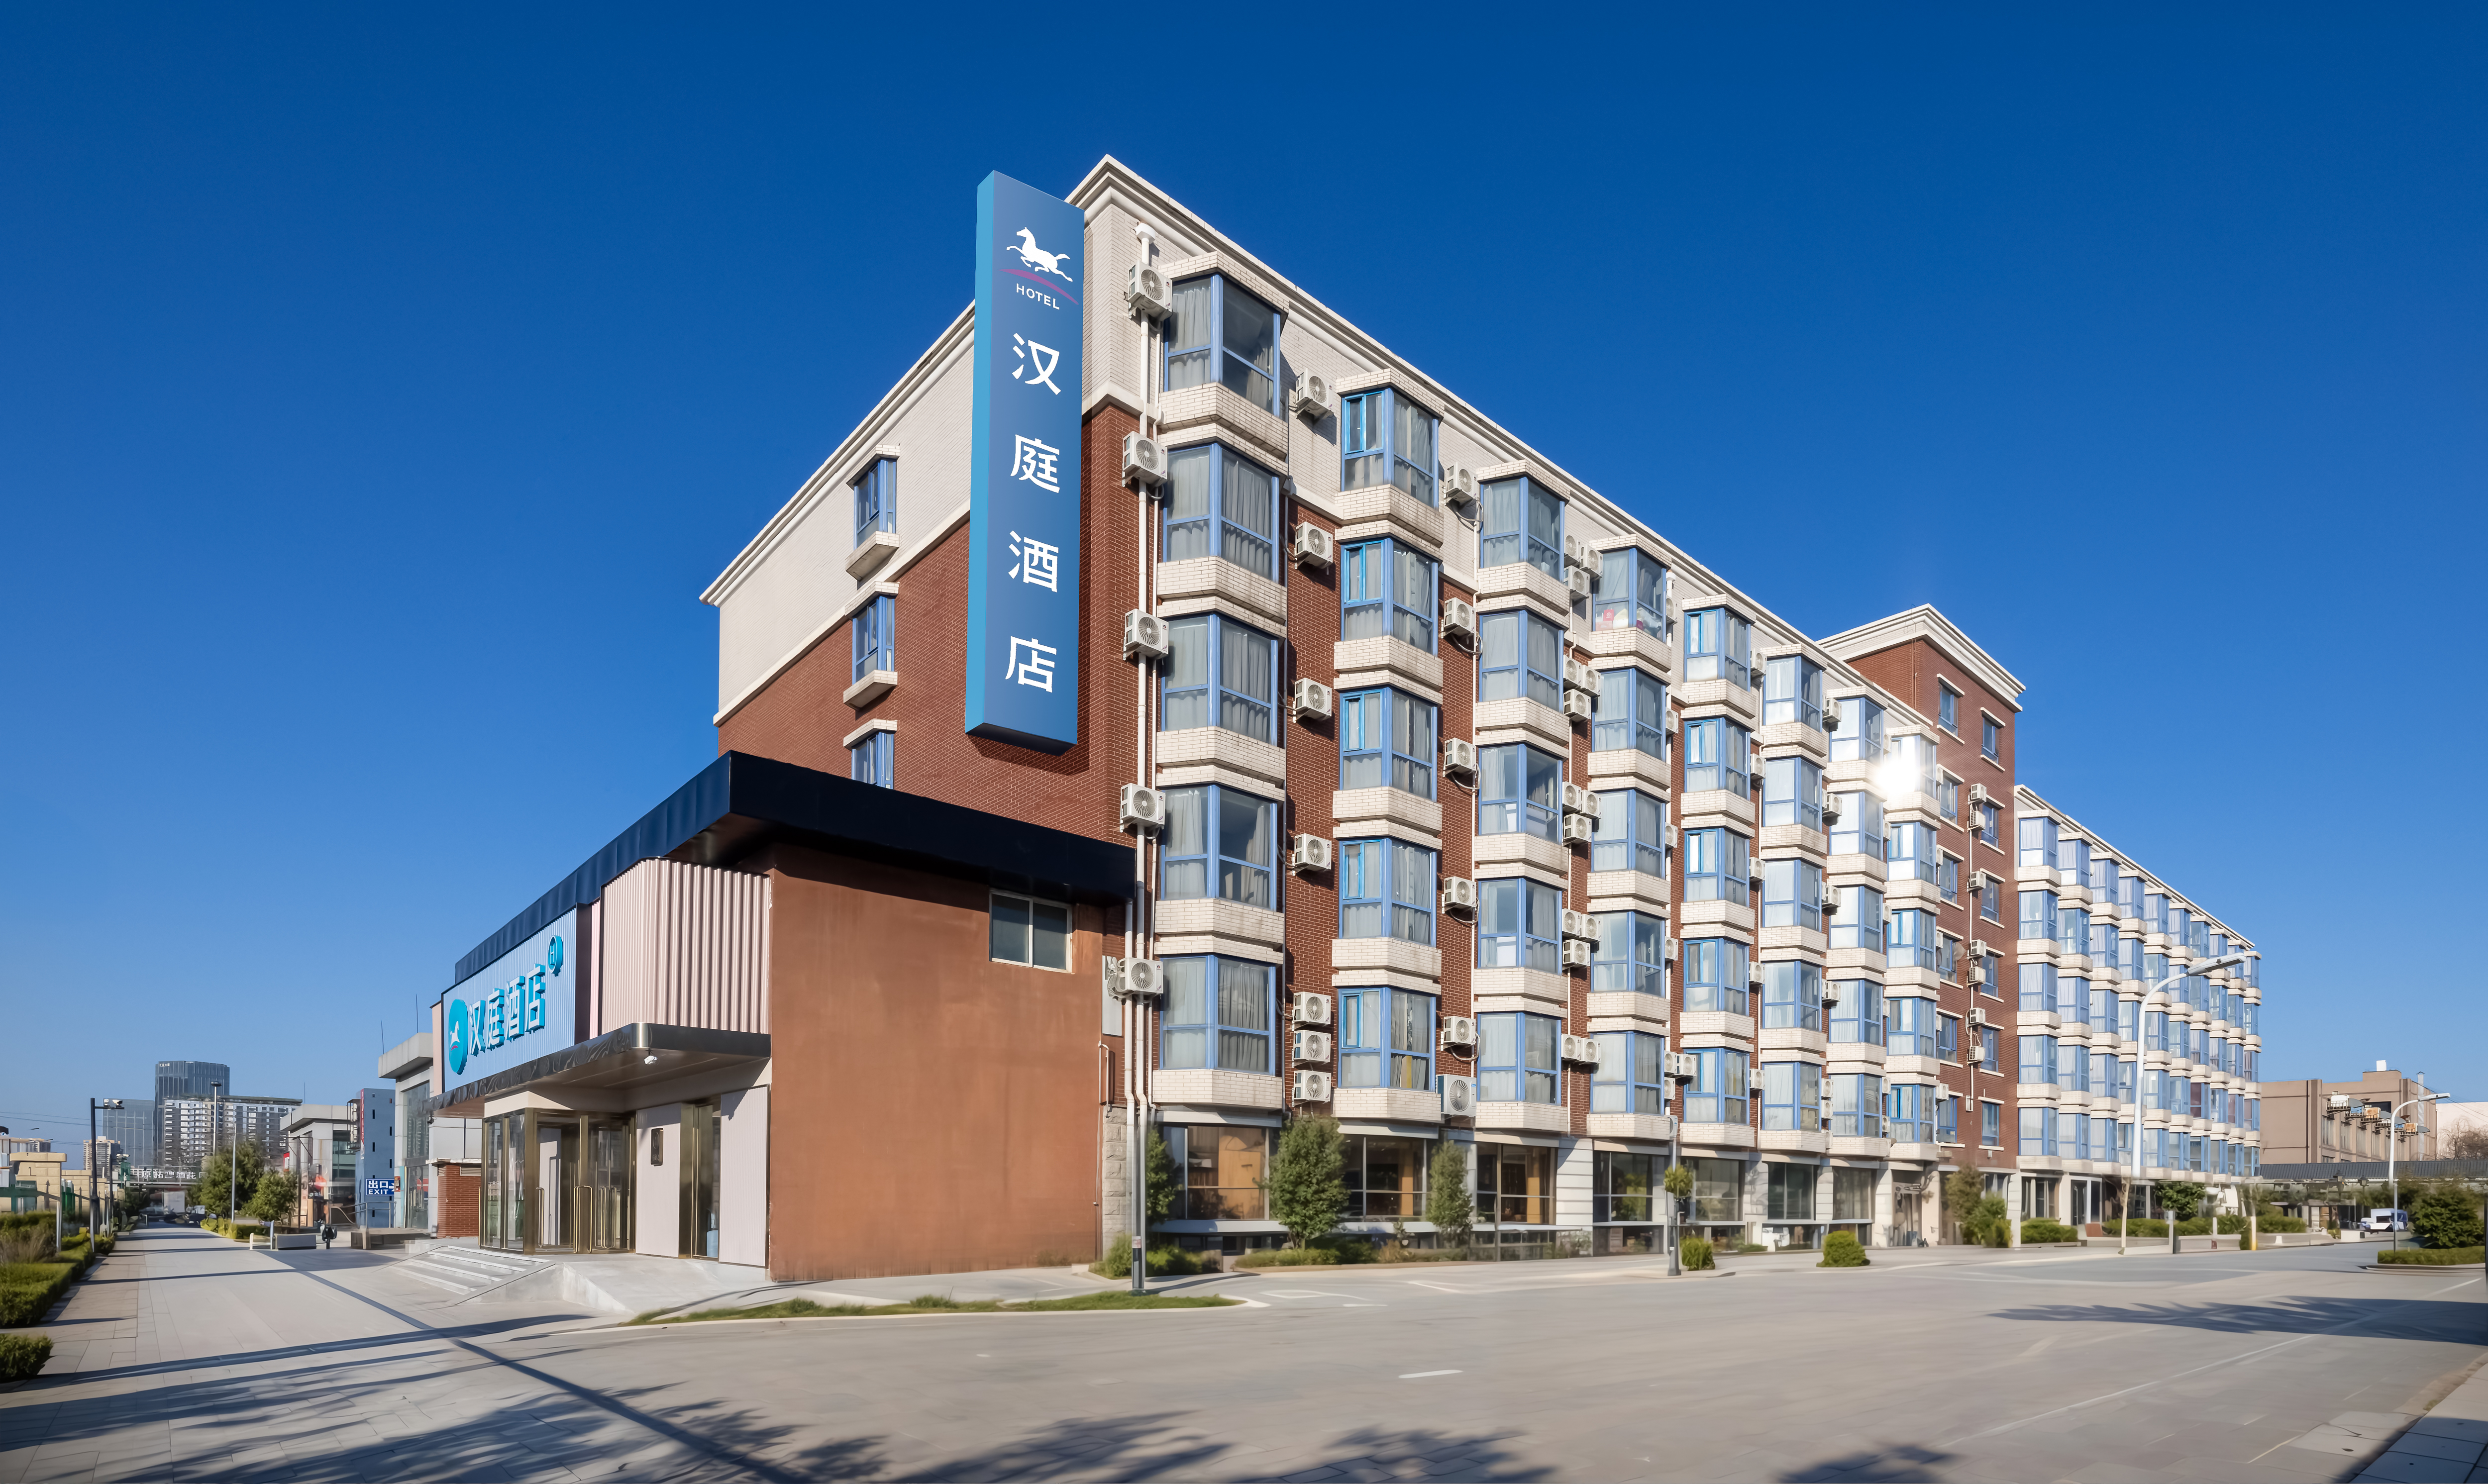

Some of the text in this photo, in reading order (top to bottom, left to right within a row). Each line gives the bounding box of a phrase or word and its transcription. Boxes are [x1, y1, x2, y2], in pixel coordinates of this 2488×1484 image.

[1016, 283, 1060, 310] HOTEL
[1005, 332, 1061, 693] 汉庭酒店
[469, 964, 545, 1055] 汉庭酒店
[368, 1180, 389, 1188] 出口
